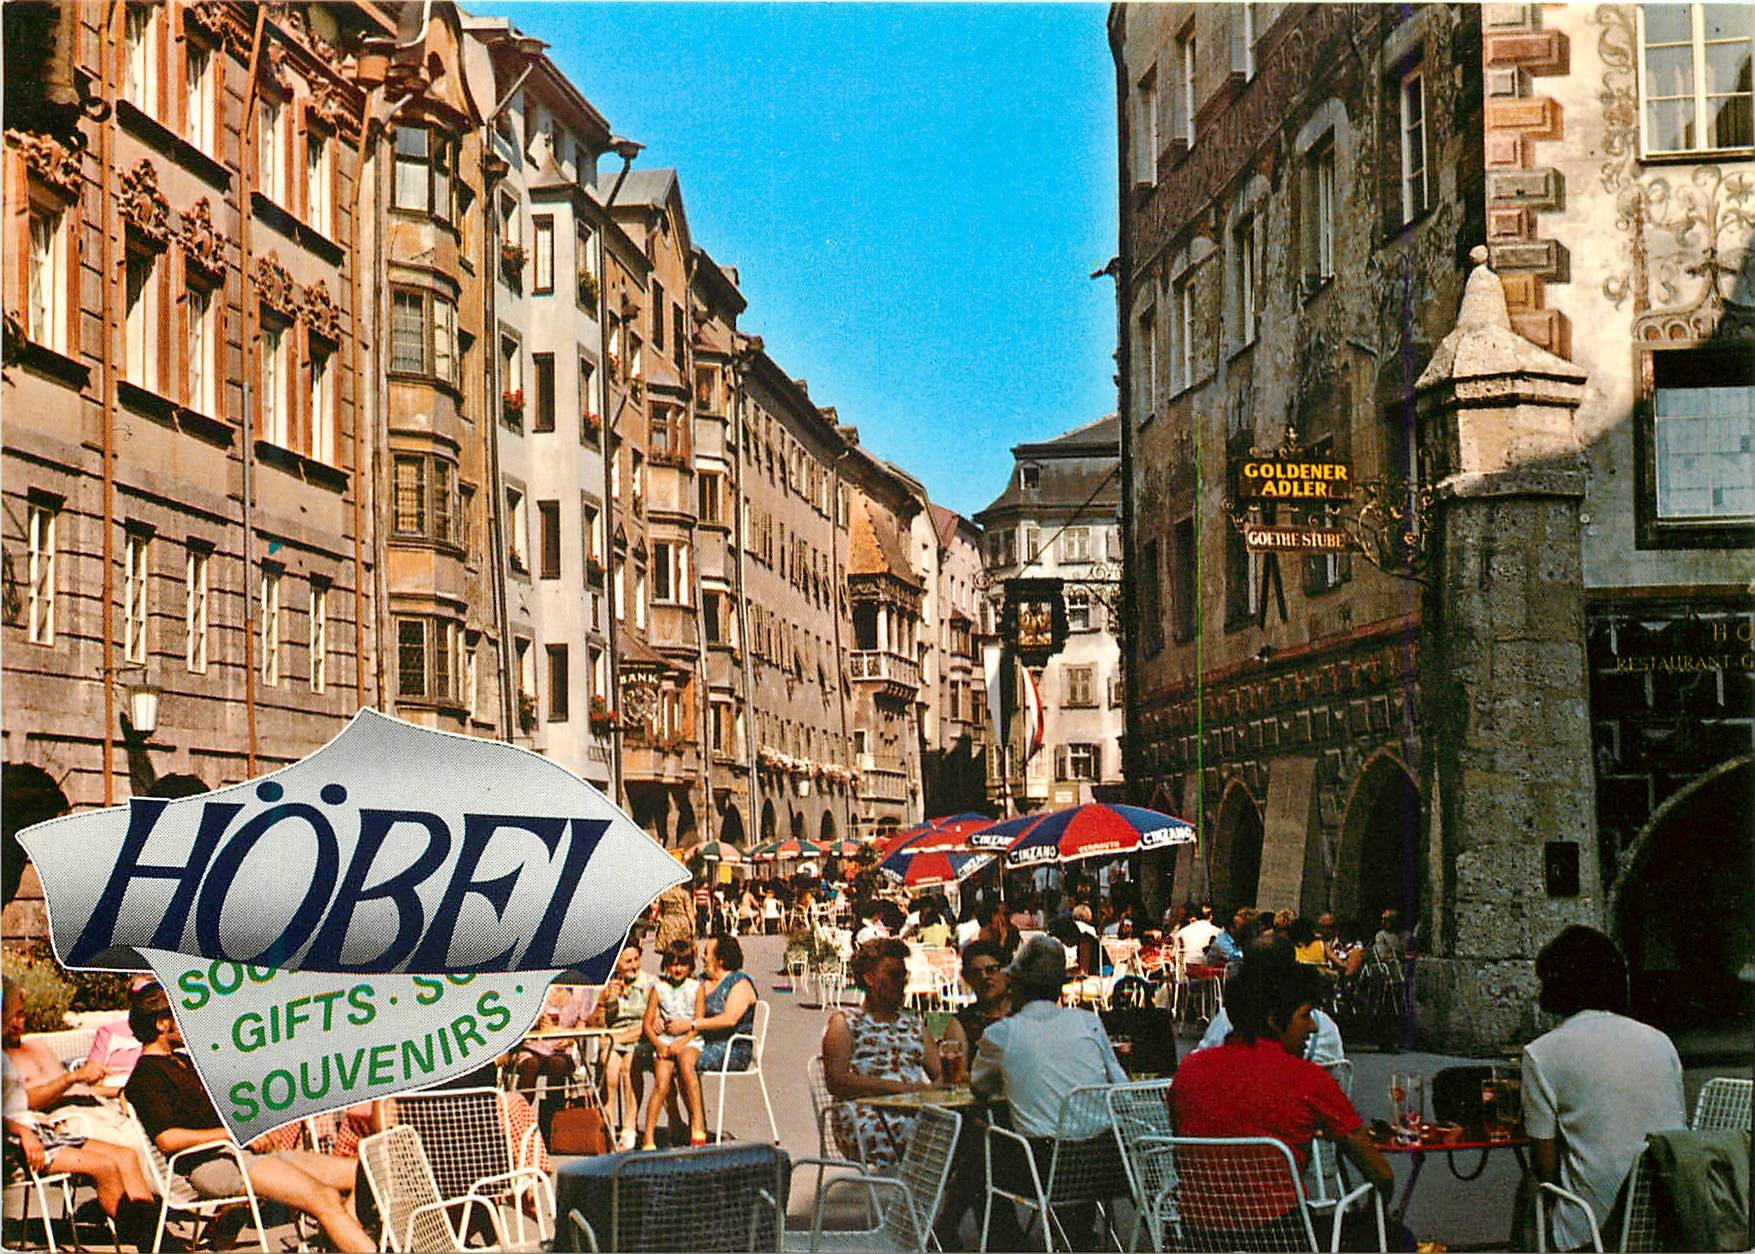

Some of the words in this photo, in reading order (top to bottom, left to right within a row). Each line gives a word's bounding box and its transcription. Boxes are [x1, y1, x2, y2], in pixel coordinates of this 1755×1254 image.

[1244, 463, 1347, 480] GOLDENER
[1261, 481, 1327, 497] ADLER
[1249, 531, 1299, 546] GOETHE
[1302, 532, 1345, 548] STUBE
[1616, 655, 1731, 672] RESTAURANT
[619, 672, 659, 684] BANK
[1143, 826, 1192, 845] CINZANO
[1010, 845, 1057, 863] CINZANO
